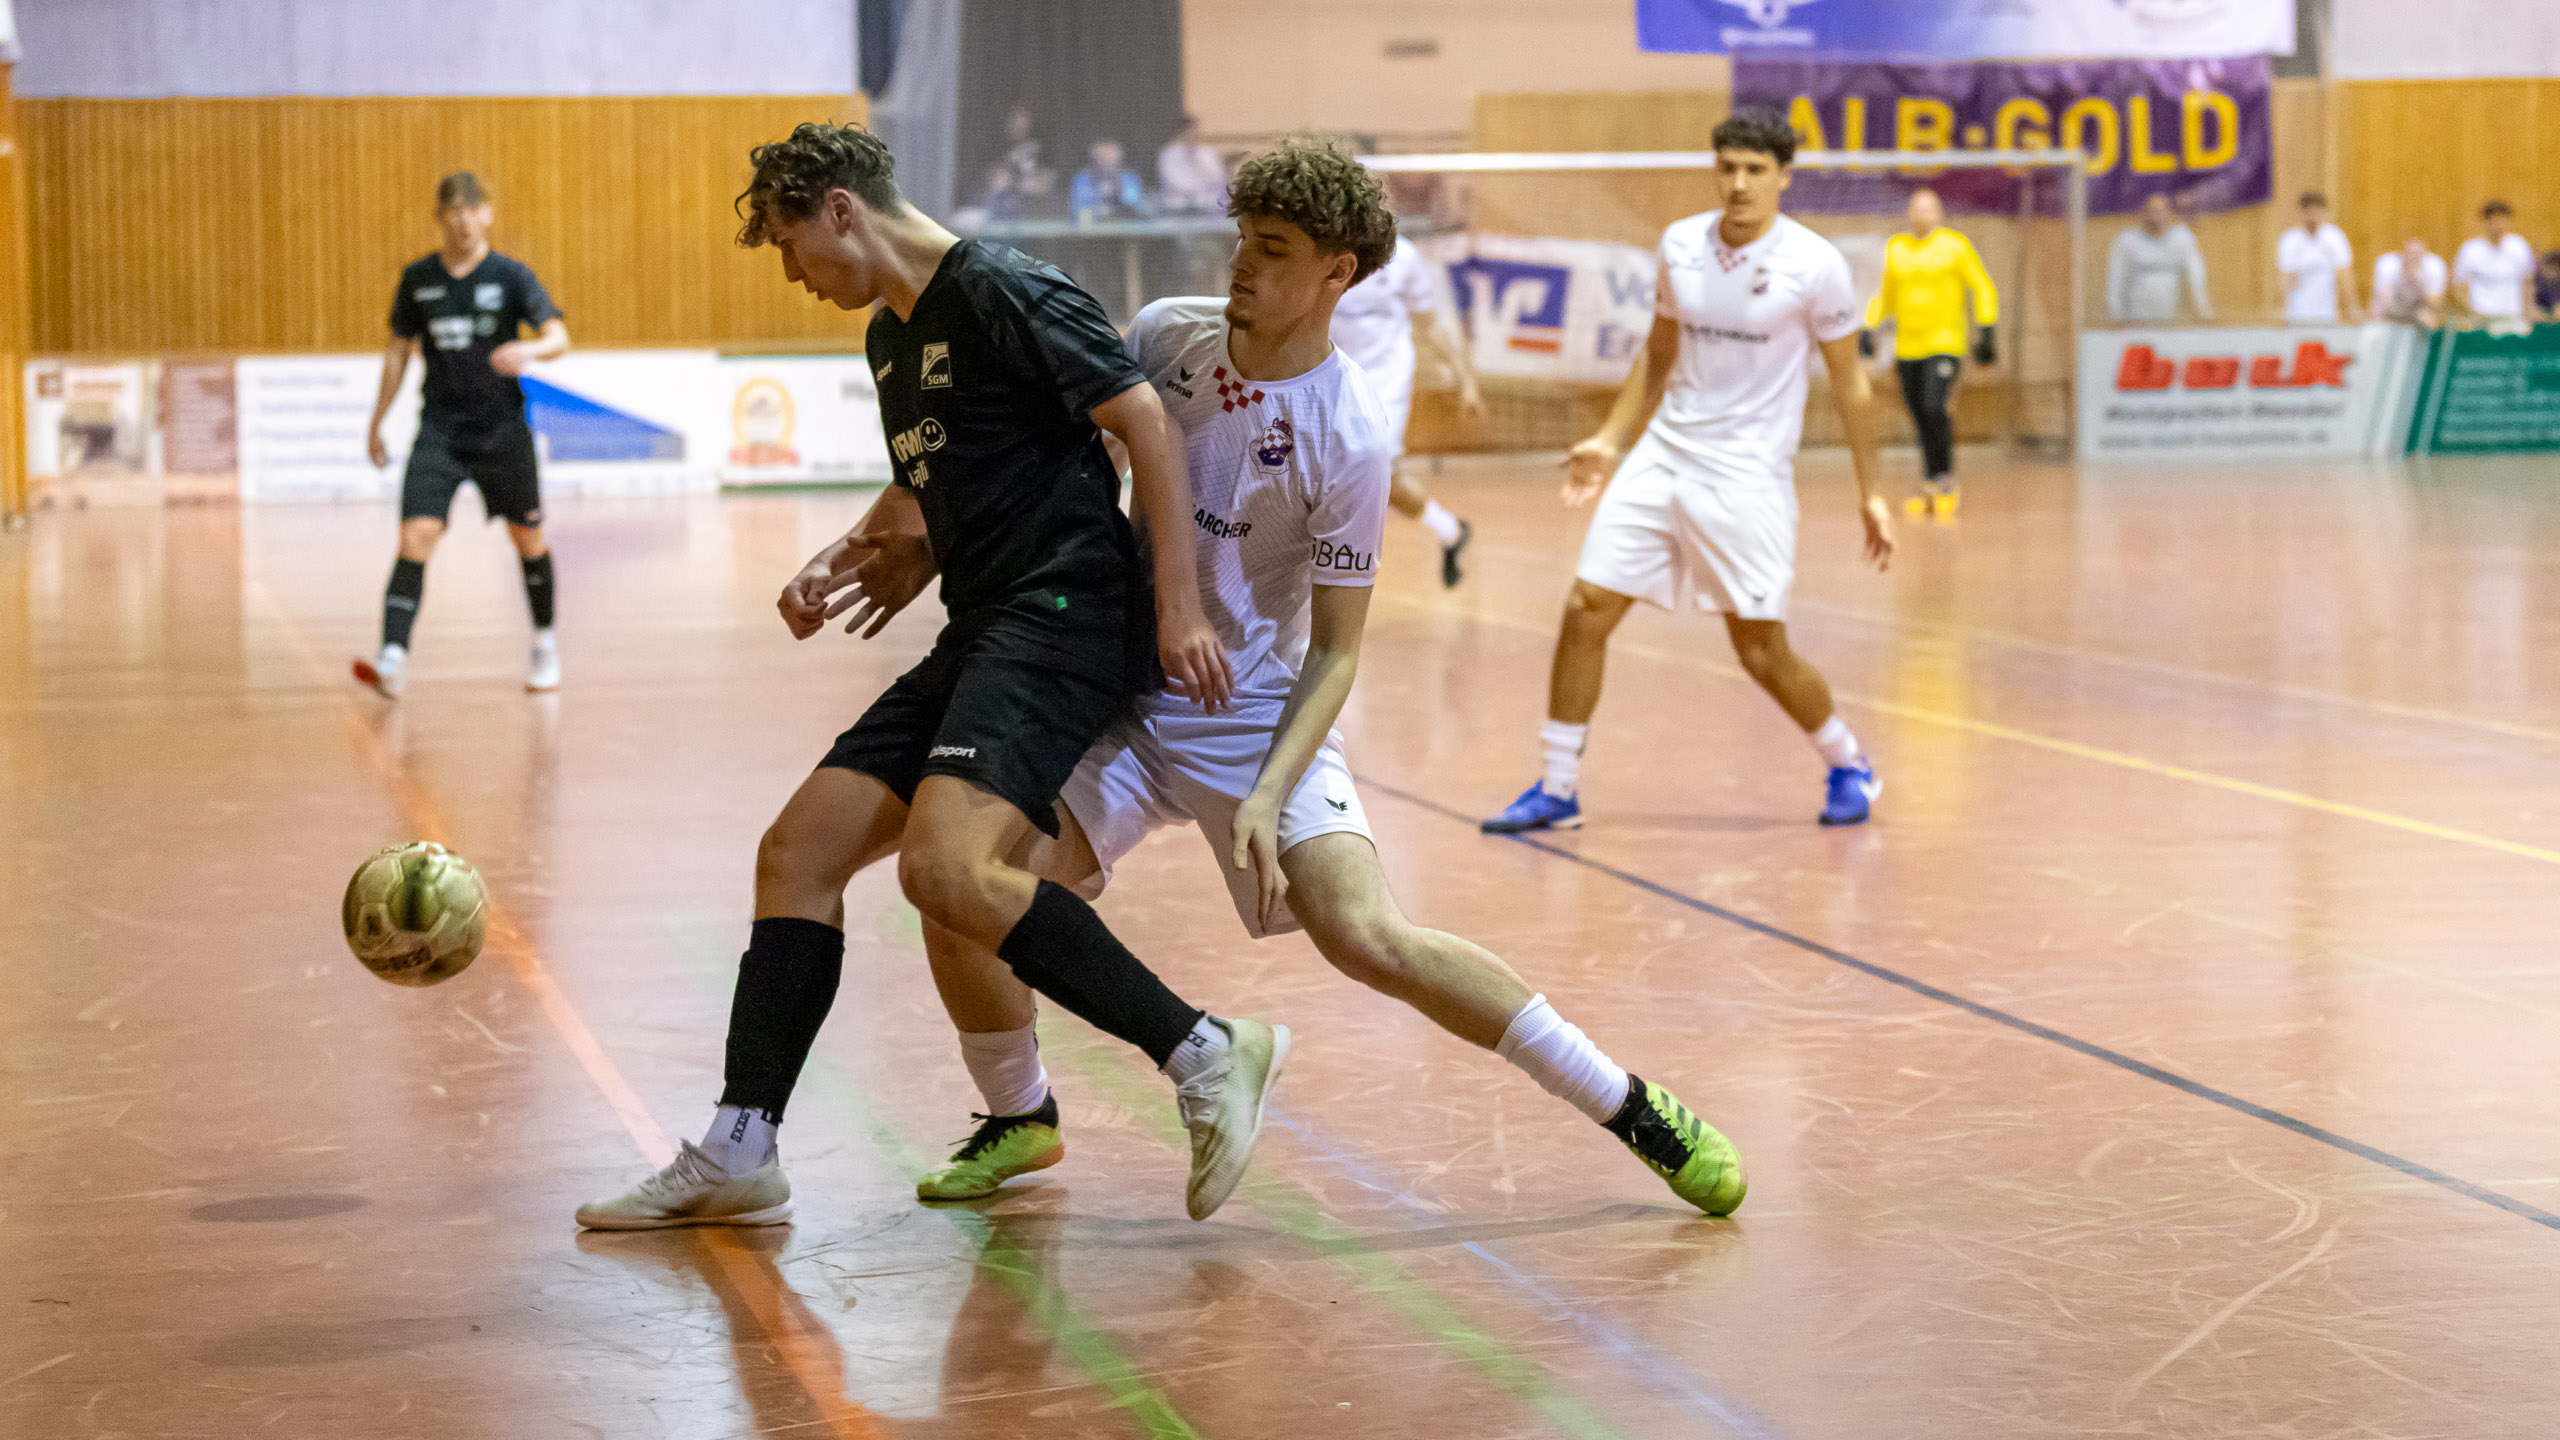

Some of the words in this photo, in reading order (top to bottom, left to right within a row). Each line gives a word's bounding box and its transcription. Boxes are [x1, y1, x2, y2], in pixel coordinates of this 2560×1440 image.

[927, 373, 949, 385] SGM
[1166, 380, 1193, 399] erima
[1193, 508, 1252, 539] ARCHER
